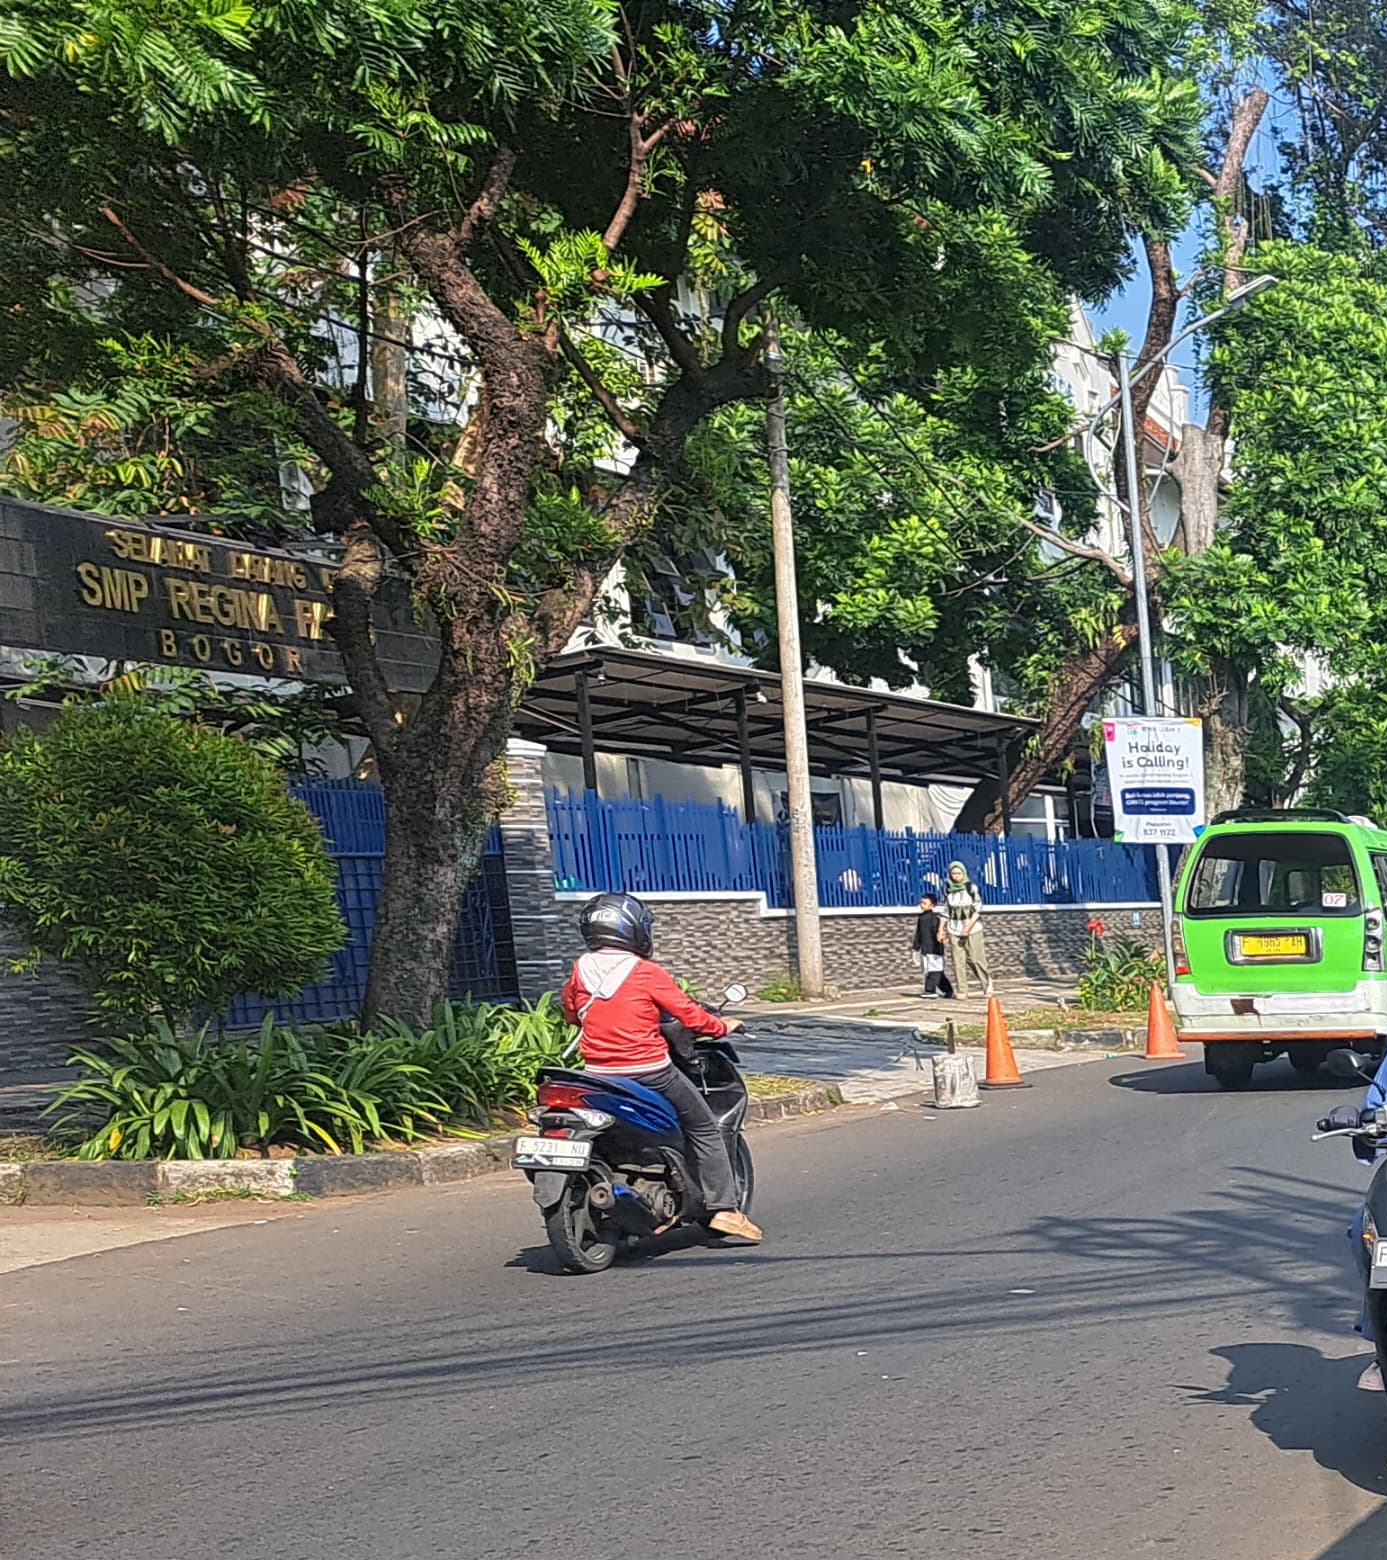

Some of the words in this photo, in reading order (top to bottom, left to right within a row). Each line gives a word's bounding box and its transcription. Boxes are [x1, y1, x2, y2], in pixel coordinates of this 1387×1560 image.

[76, 562, 149, 613] SMP
[164, 576, 285, 635] REGINA
[160, 628, 304, 673] BOGOR
[1121, 756, 1134, 769] is
[1136, 756, 1190, 771] Calling!
[1127, 741, 1182, 756] Holiday
